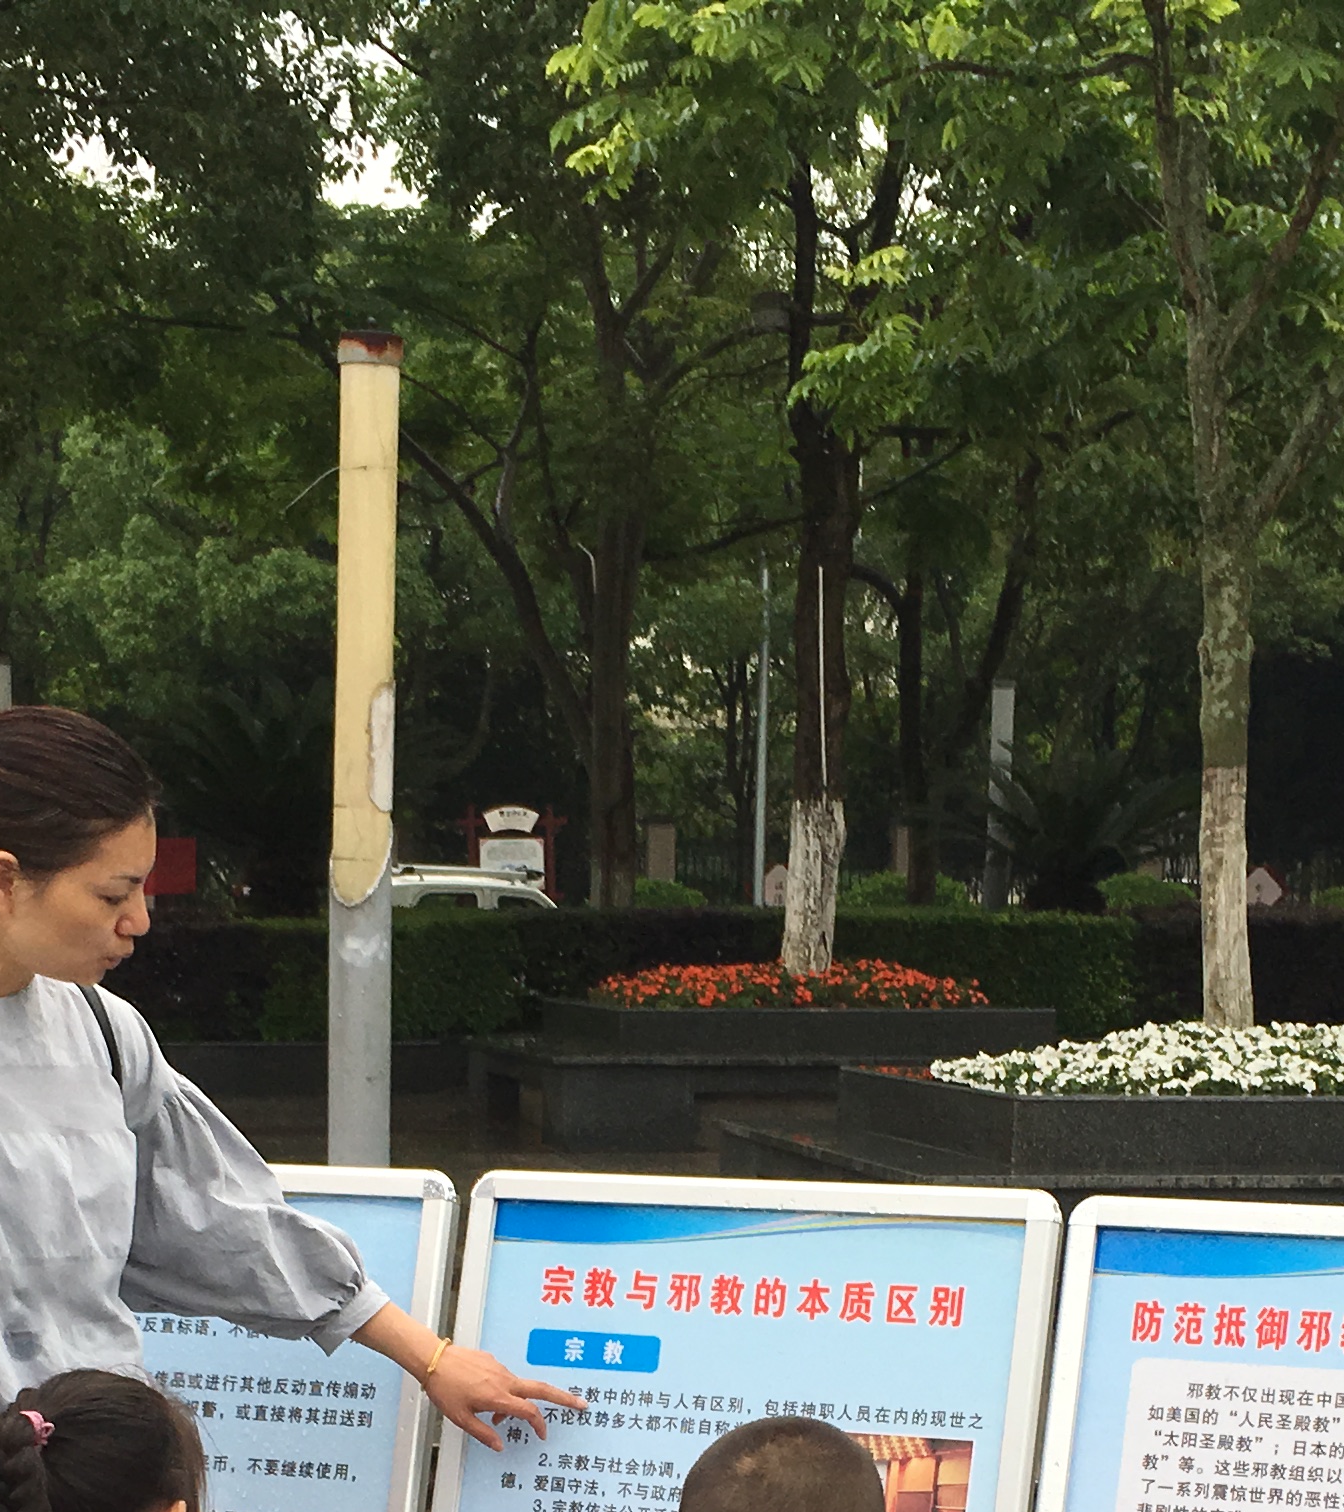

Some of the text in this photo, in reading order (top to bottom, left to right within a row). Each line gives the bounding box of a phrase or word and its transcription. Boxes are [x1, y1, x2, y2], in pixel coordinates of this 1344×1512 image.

[540, 1264, 965, 1328] 宗教与邪教的本质区别
[562, 1336, 625, 1365] 宗教
